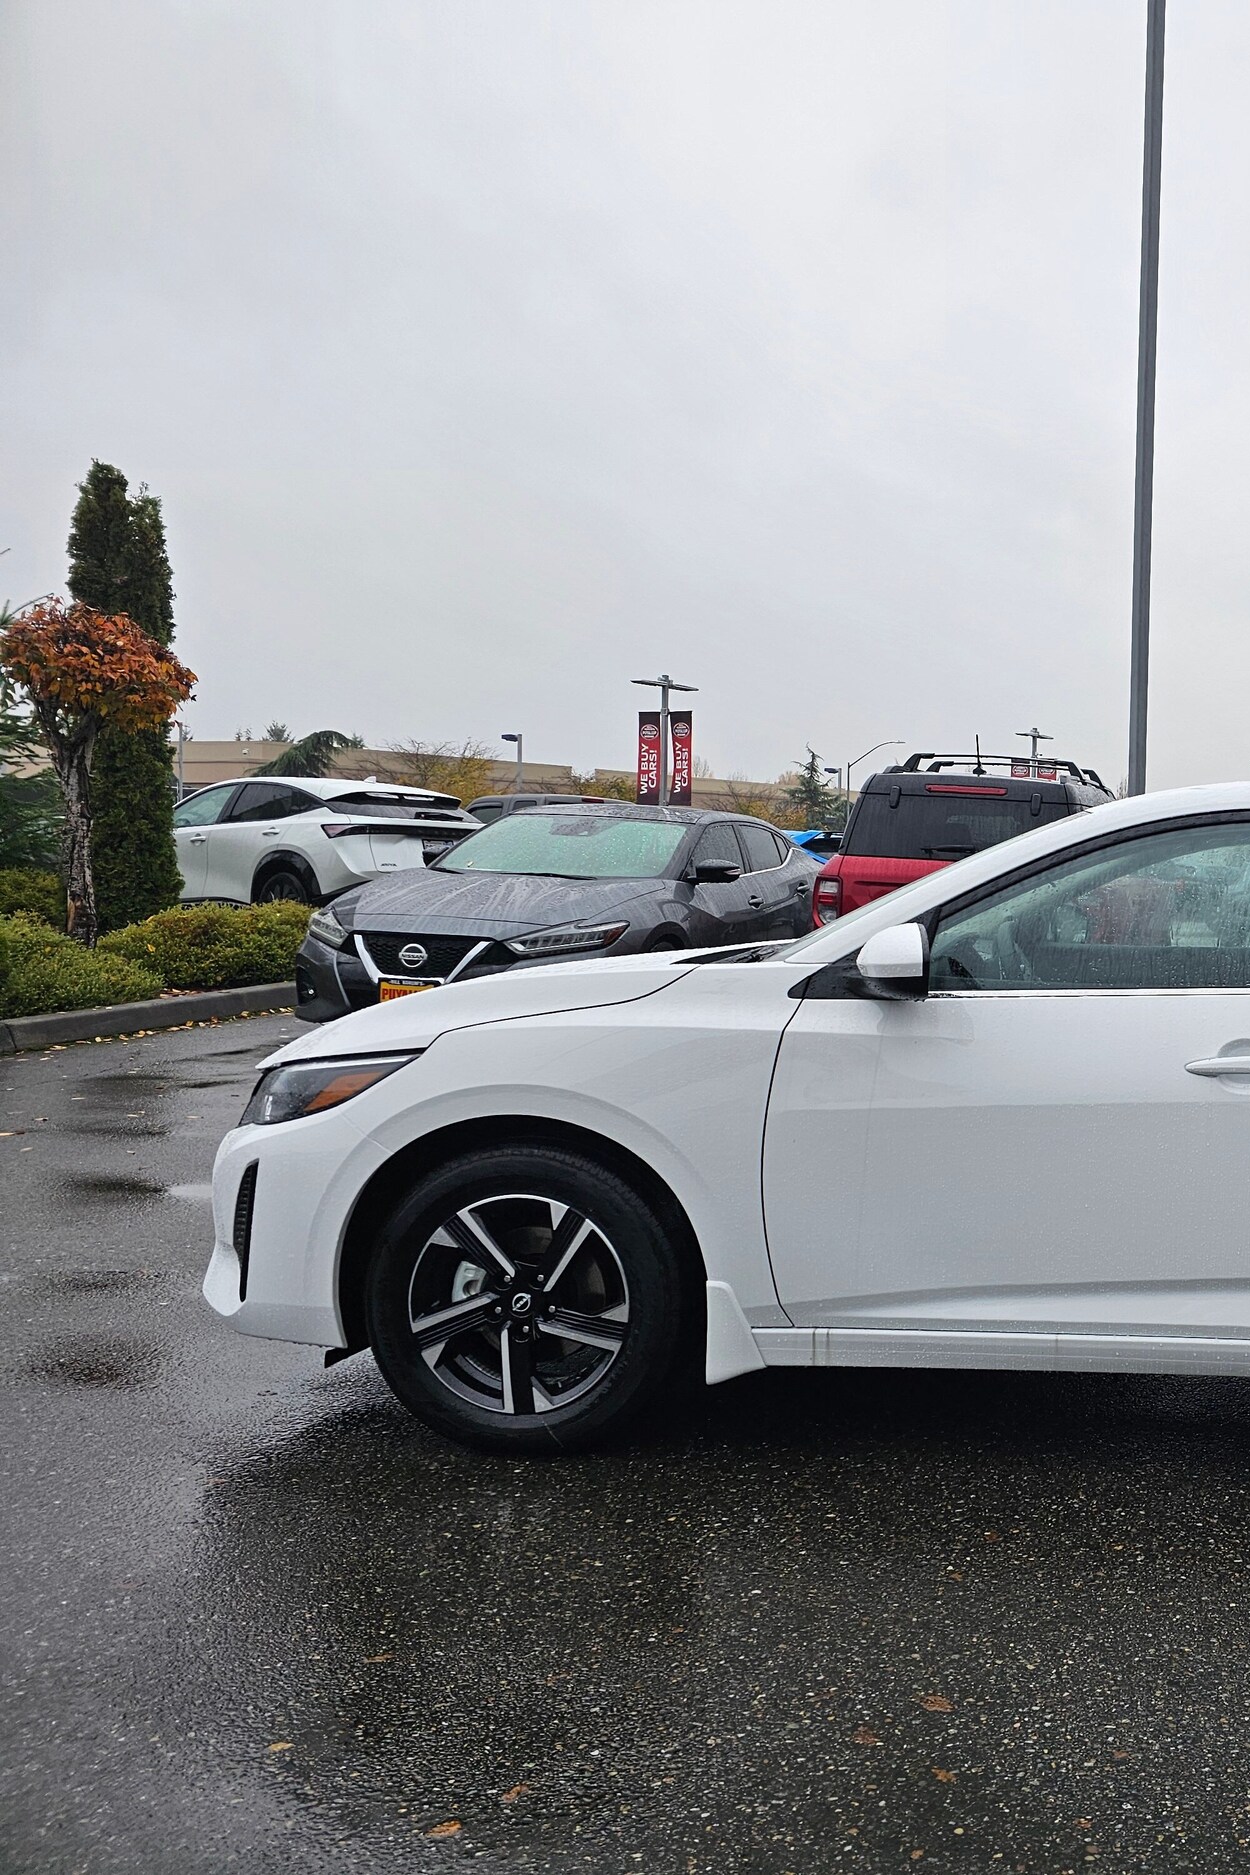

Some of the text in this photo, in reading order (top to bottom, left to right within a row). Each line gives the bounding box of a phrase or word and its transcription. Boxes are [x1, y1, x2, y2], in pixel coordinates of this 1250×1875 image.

[640, 743, 649, 794] WE BUY
[649, 750, 657, 788] CARS!
[674, 773, 681, 793] WE
